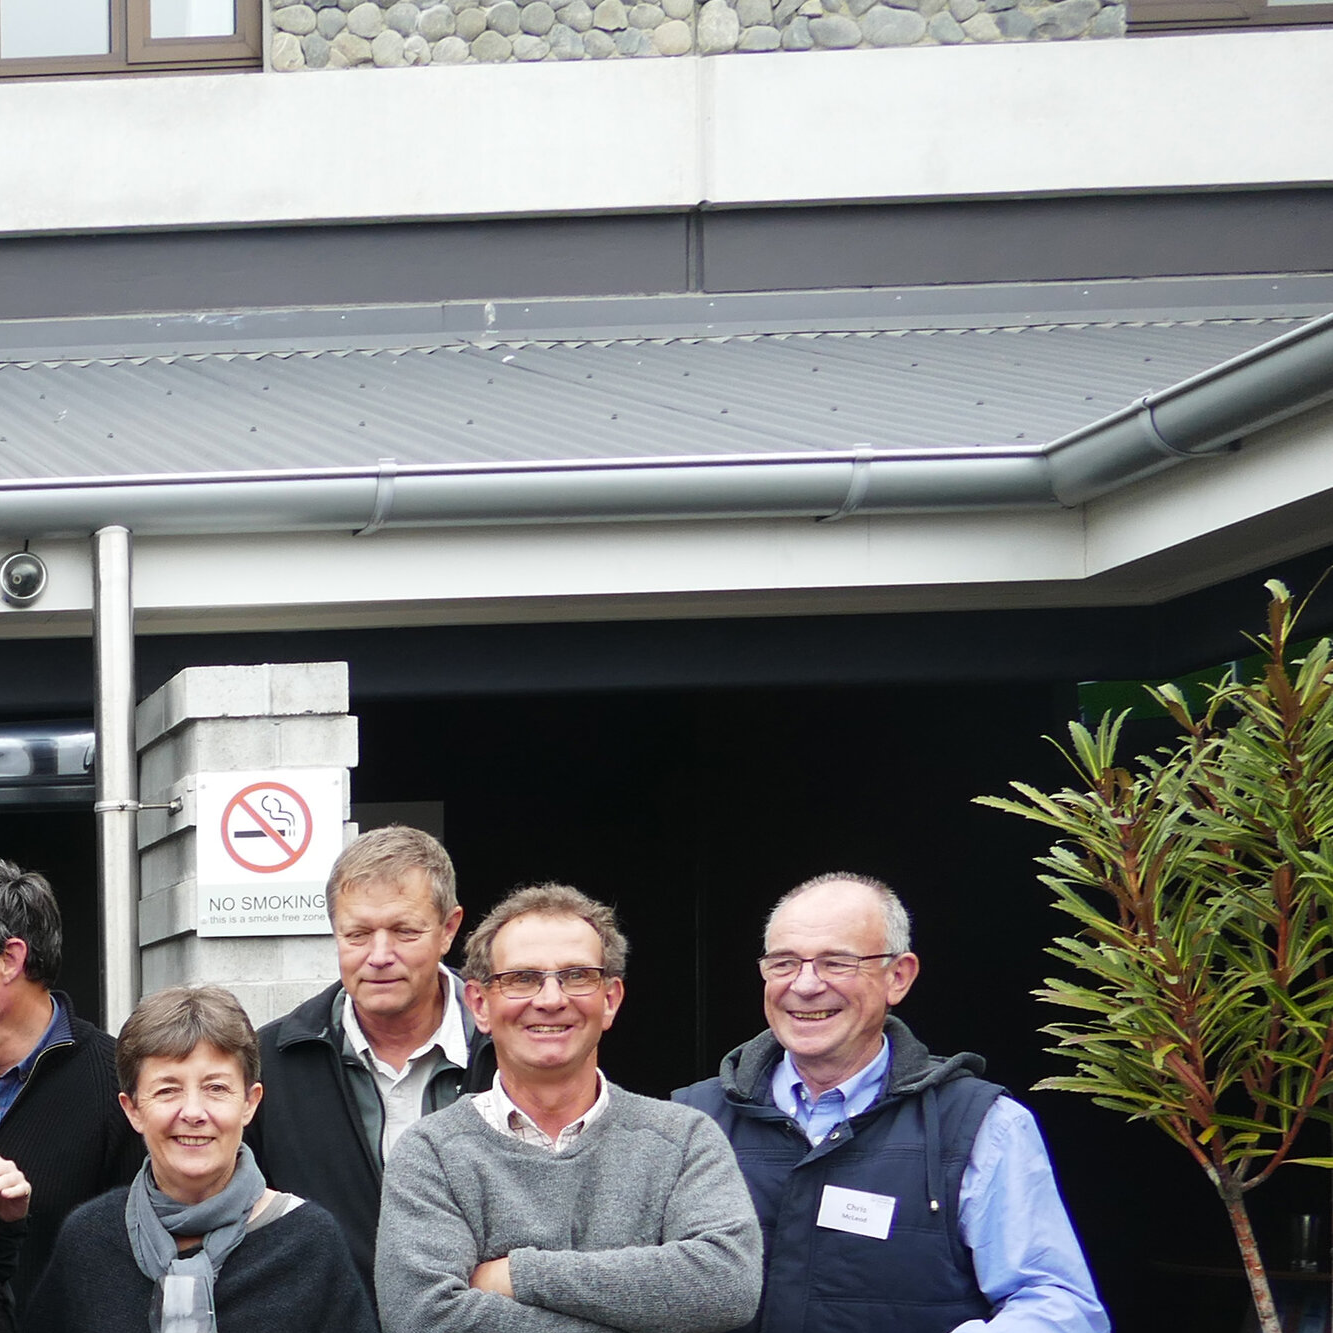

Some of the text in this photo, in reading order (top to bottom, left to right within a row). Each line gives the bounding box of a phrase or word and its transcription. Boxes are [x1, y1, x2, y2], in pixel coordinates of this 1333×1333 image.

[209, 894, 325, 912] NO SMOKING
[209, 915, 227, 924] this
[229, 915, 237, 923] is
[248, 913, 279, 923] smoke
[282, 913, 300, 922] free
[302, 913, 325, 921] zone
[846, 1203, 867, 1213] Chris
